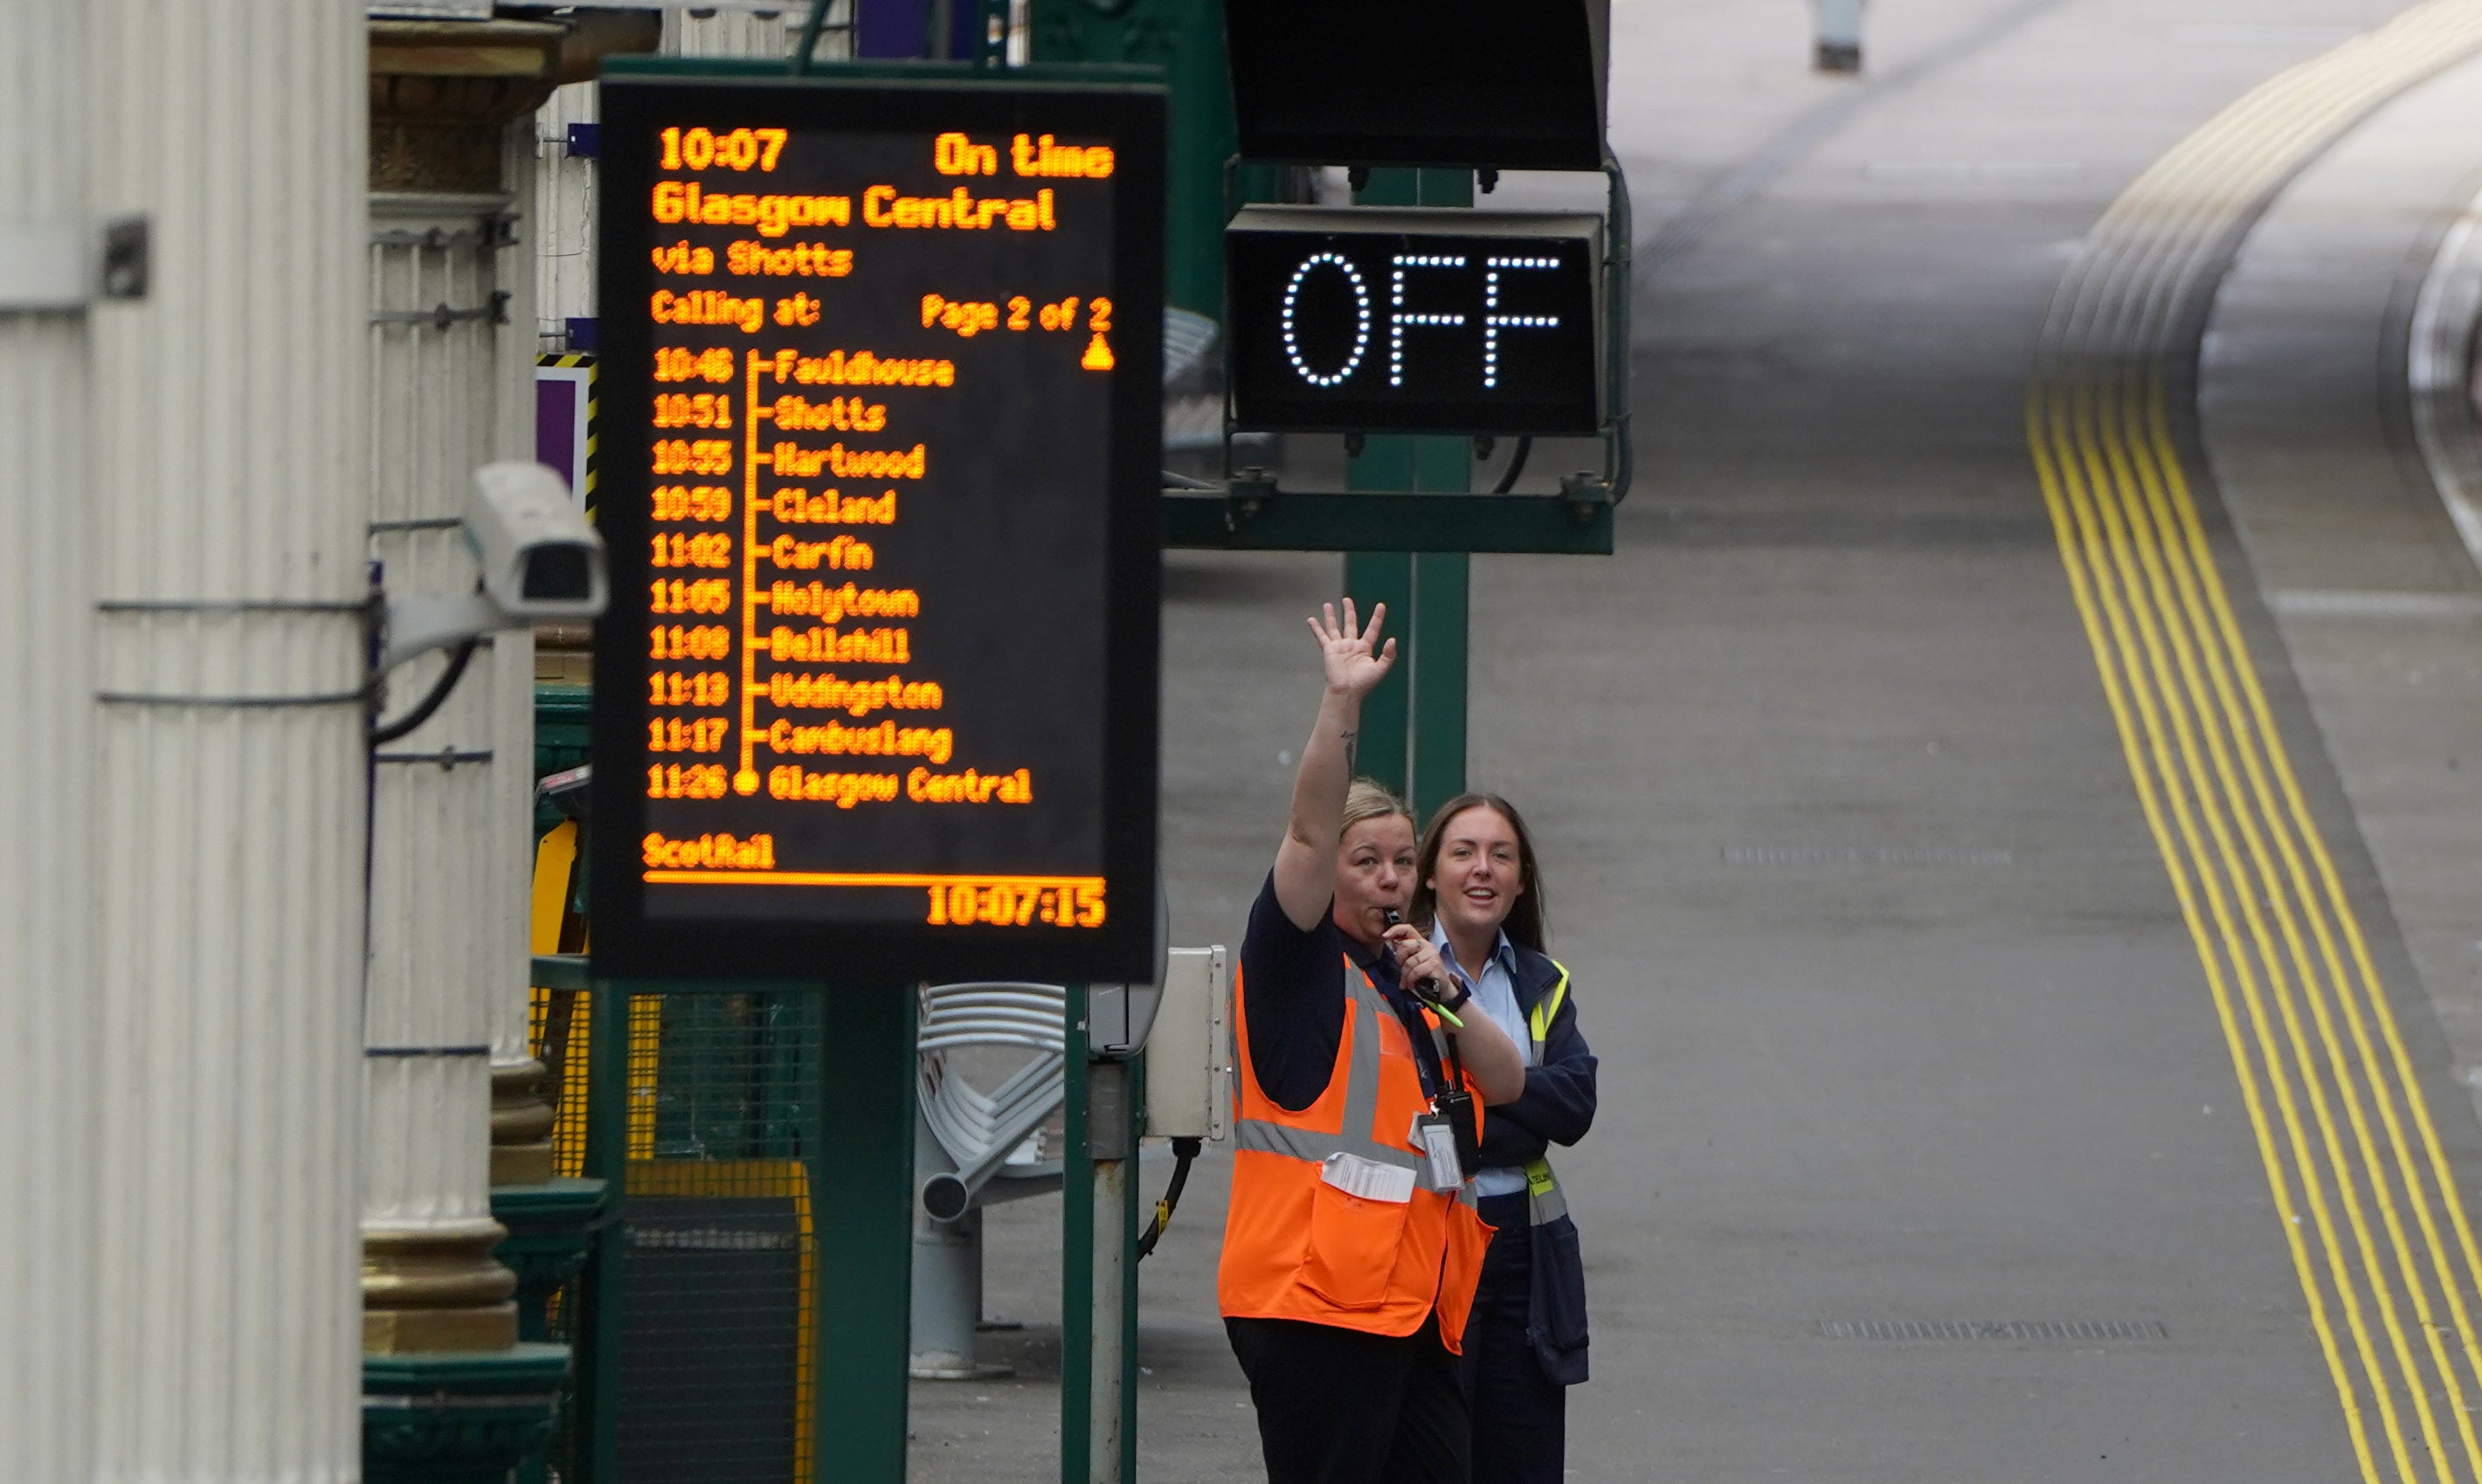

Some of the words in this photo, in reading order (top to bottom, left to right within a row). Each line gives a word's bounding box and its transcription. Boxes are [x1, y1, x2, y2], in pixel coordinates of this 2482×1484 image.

[660, 128, 787, 171] 10:07
[935, 133, 997, 175] On
[1011, 134, 1114, 178] time
[653, 181, 851, 237] Glasgow
[863, 185, 1055, 231] Central
[652, 240, 714, 274] via
[727, 240, 853, 277] Shotts
[651, 290, 764, 333] Calling
[773, 292, 820, 326] at:
[922, 294, 999, 337] Page
[1007, 296, 1030, 332] 2
[1040, 297, 1079, 331] of
[1089, 297, 1112, 332] 2
[1282, 252, 1560, 388] OFF
[653, 348, 734, 383] 10:46
[774, 349, 954, 387] Fauldhouse
[653, 393, 732, 429] 10:51
[773, 395, 886, 431] Shotts
[652, 439, 732, 475] 10:55
[773, 442, 925, 479] Hartwood
[652, 486, 731, 521] 10:59
[772, 488, 895, 524] Cleland
[651, 533, 731, 568] 11:02
[772, 535, 874, 569] Carfin
[651, 578, 730, 614] 11:05
[771, 580, 919, 624] Holytown
[770, 626, 910, 663] Bellshill
[649, 671, 729, 706] 11:13
[769, 673, 943, 715] Uddingston
[648, 717, 729, 752] 11:17
[769, 719, 952, 764] Cambuslang
[647, 763, 728, 798] 11:26
[768, 765, 898, 809] Glasgow
[907, 769, 1033, 803] Central
[642, 832, 775, 869] ScotRail
[927, 886, 1106, 928] 10:07:15
